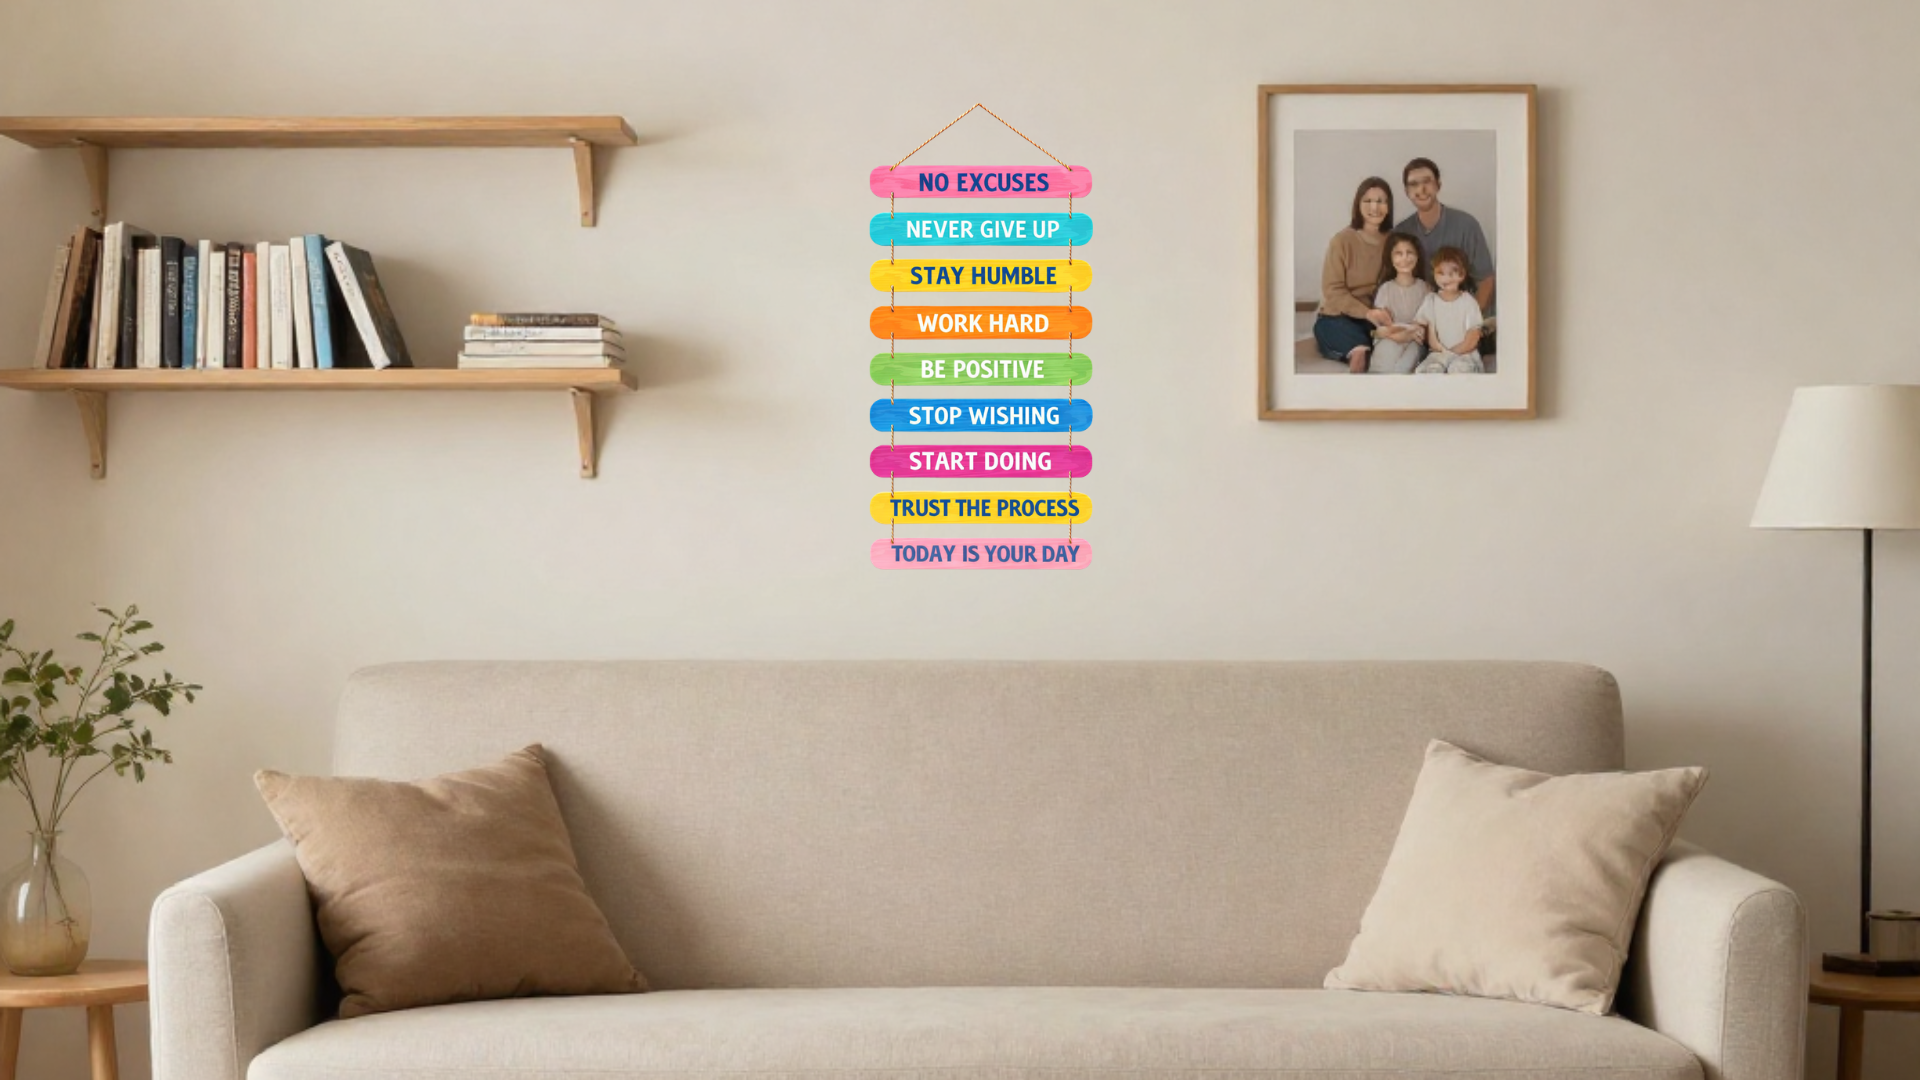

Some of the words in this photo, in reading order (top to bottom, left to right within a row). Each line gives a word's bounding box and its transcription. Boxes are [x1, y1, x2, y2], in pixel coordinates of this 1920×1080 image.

[919, 172, 949, 192] NO
[957, 172, 1050, 192] EXCUSES
[906, 220, 974, 239] NEVER
[980, 220, 1027, 239] GIVE
[1033, 220, 1060, 239] UP
[910, 266, 965, 285] STAY
[971, 266, 1057, 285] HUMBLE
[917, 313, 984, 333] WORK
[989, 313, 1049, 333] HARD
[921, 360, 946, 379] BE
[954, 360, 1044, 379] POSITIVE
[908, 406, 962, 425] STOP
[969, 406, 1060, 425] WISHING
[909, 451, 978, 471] START
[984, 451, 1052, 471] DOING
[890, 499, 951, 517] TRUST
[955, 499, 991, 517] THE
[997, 499, 1080, 517] PROCESS
[891, 544, 956, 562] TODAY
[962, 544, 980, 562] IS
[985, 544, 1037, 563] YOUR
[1042, 544, 1080, 563] DAY
